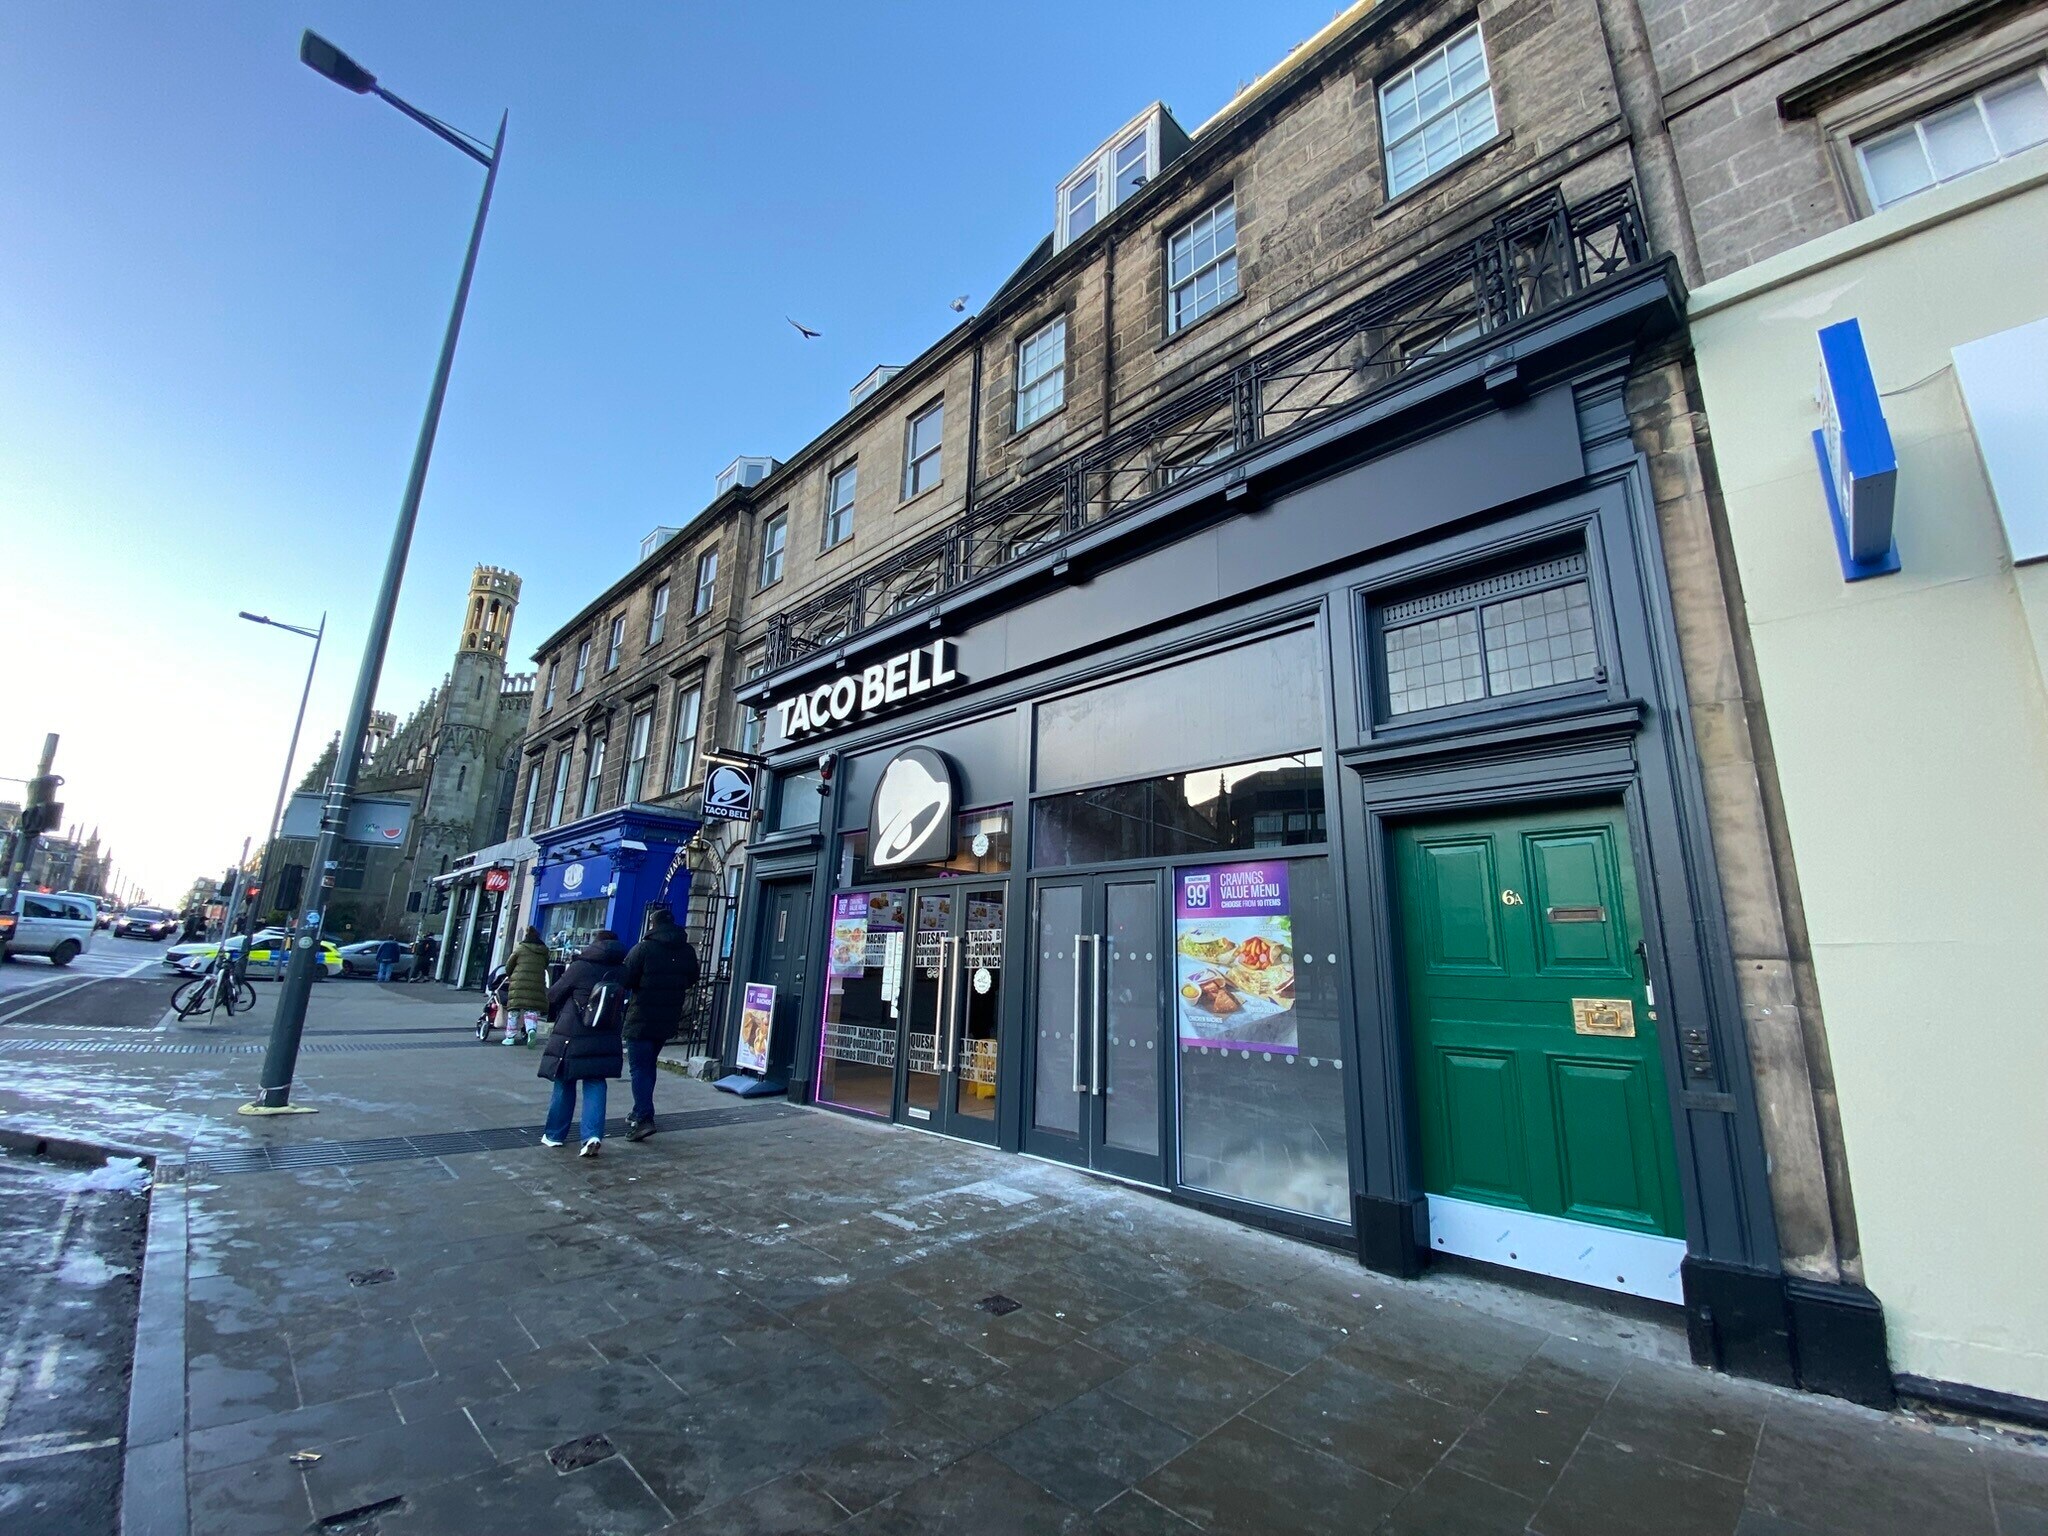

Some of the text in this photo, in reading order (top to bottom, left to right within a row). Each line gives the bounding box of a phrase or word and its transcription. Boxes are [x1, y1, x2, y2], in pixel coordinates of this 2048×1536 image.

[777, 638, 956, 739] TACO BELL
[704, 805, 750, 820] TACO BELL
[487, 874, 507, 889] illy
[1219, 870, 1264, 887] CRAVINGS
[1220, 883, 1280, 899] VALUE MENU
[1502, 889, 1524, 906] 6A
[1221, 900, 1242, 909] CHOOSE
[1264, 898, 1282, 907] ITEMS
[970, 930, 992, 942] TACOS
[966, 1040, 989, 1054] TACOS
